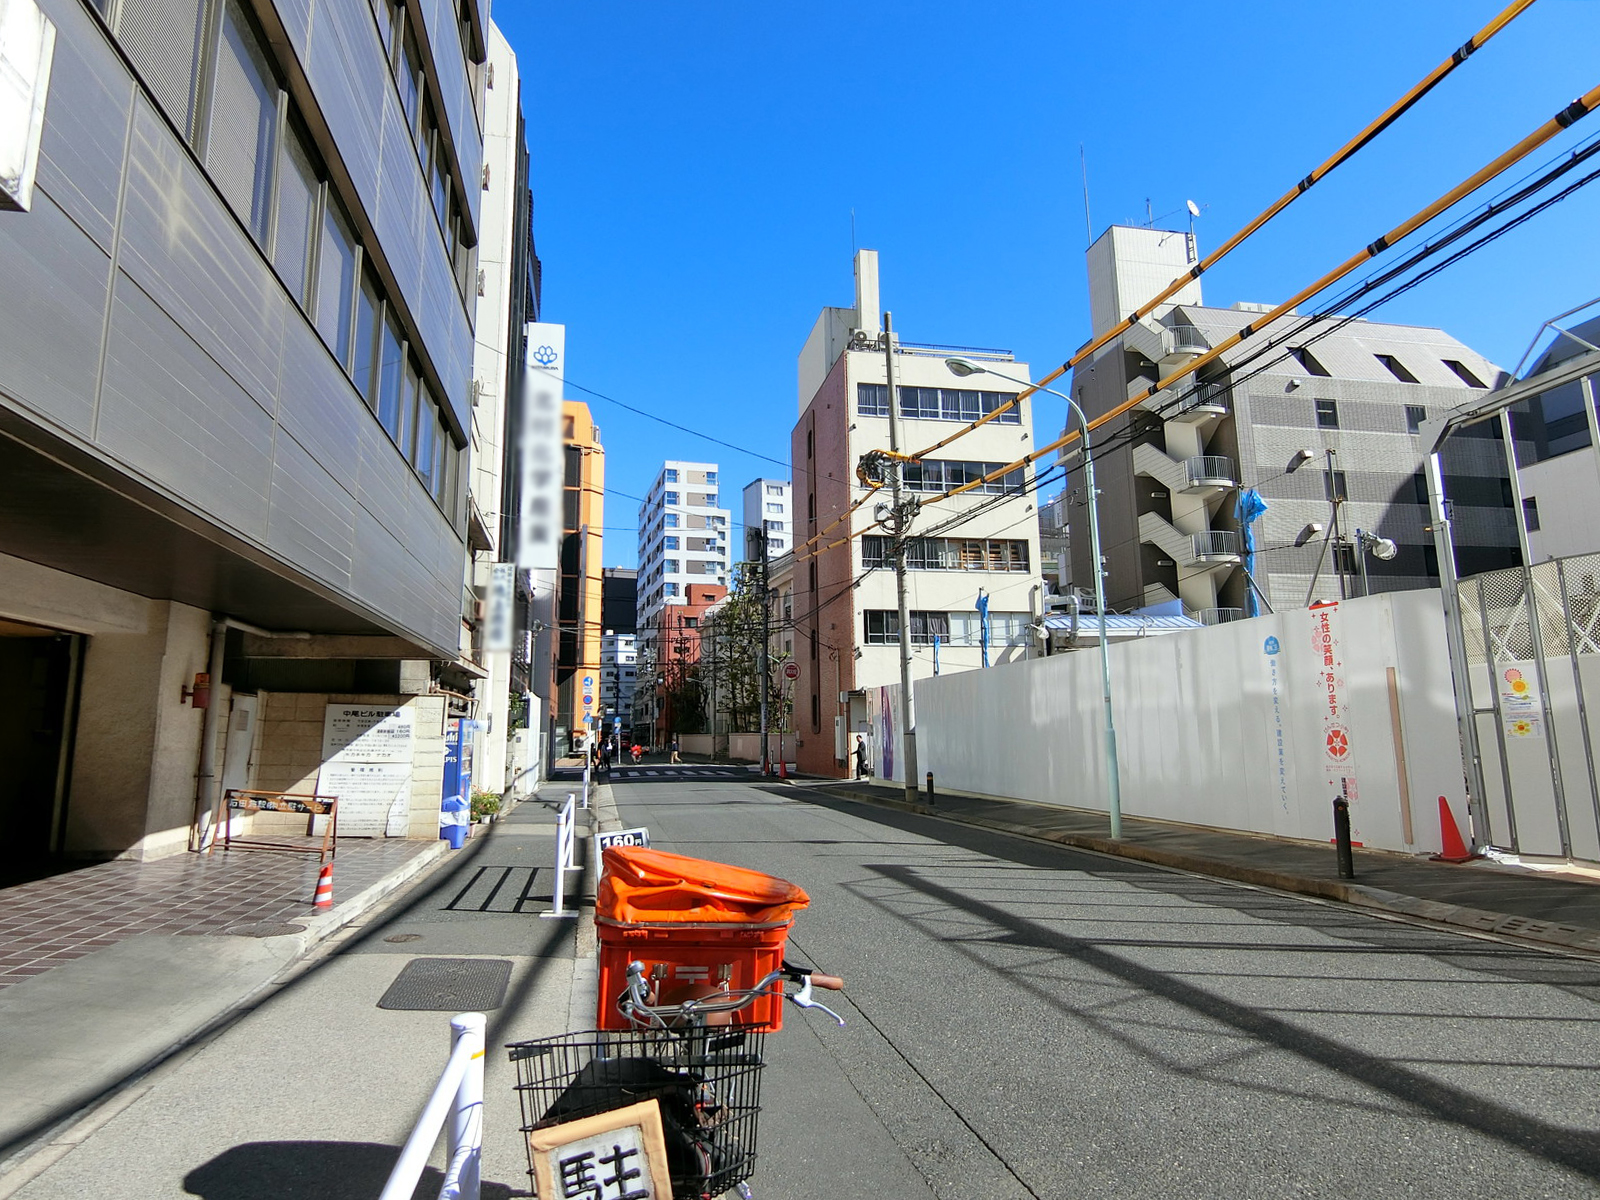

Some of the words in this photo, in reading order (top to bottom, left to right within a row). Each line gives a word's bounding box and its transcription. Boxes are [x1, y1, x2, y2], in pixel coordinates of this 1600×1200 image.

[1320, 612, 1340, 719] 女性の笑顔、あります。
